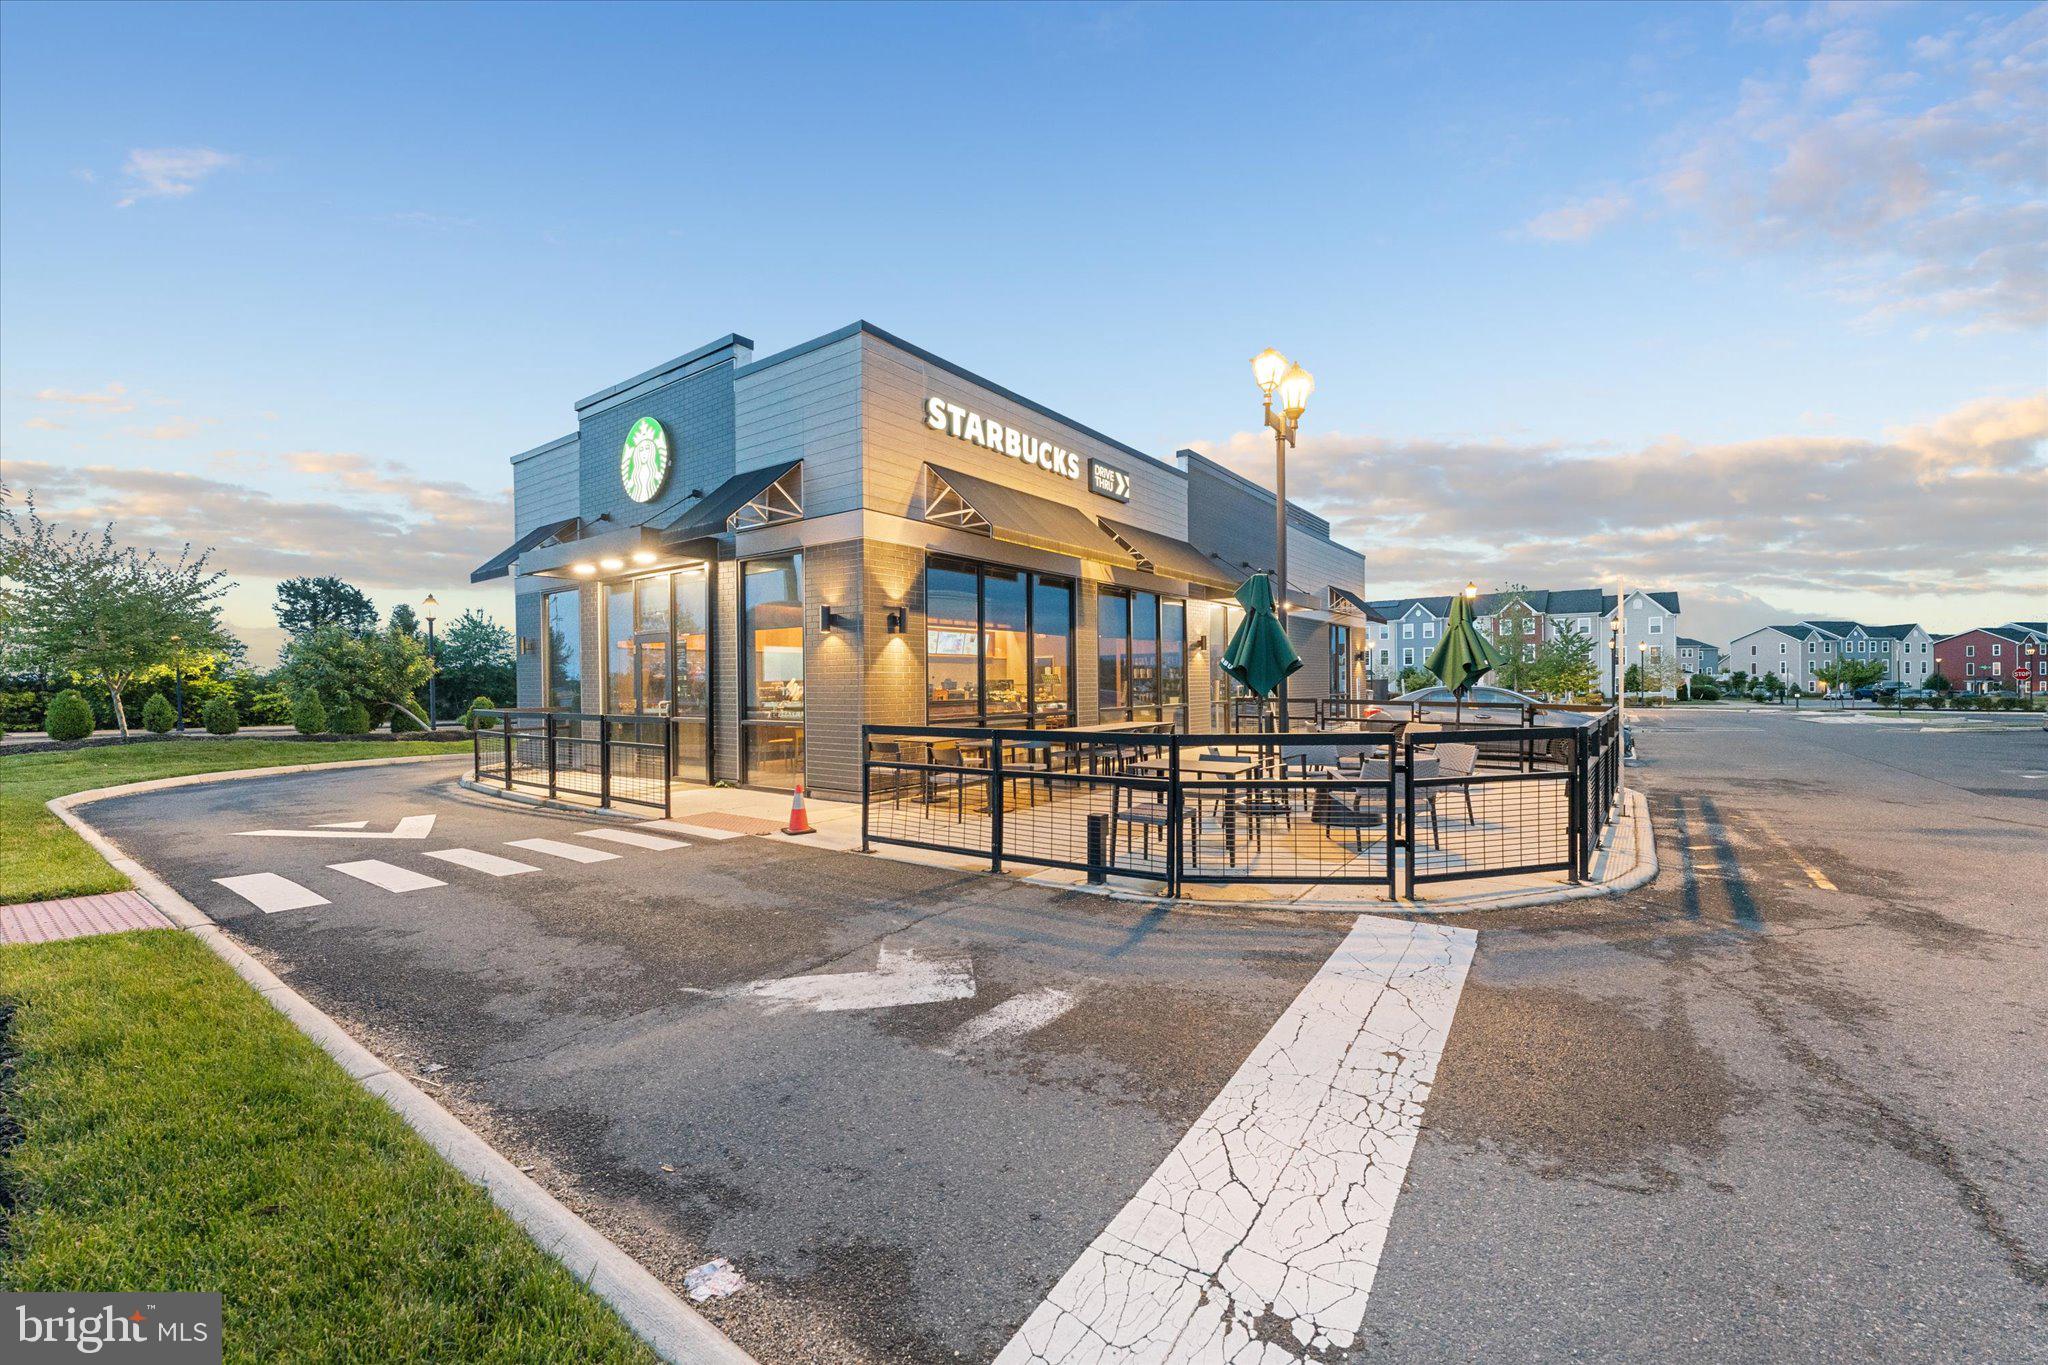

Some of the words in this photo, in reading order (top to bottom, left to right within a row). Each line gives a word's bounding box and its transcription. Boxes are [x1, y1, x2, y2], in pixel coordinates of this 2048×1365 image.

[927, 396, 1080, 480] STARBUCKS
[1094, 464, 1115, 482] DRIVE
[1094, 475, 1114, 492] THRU
